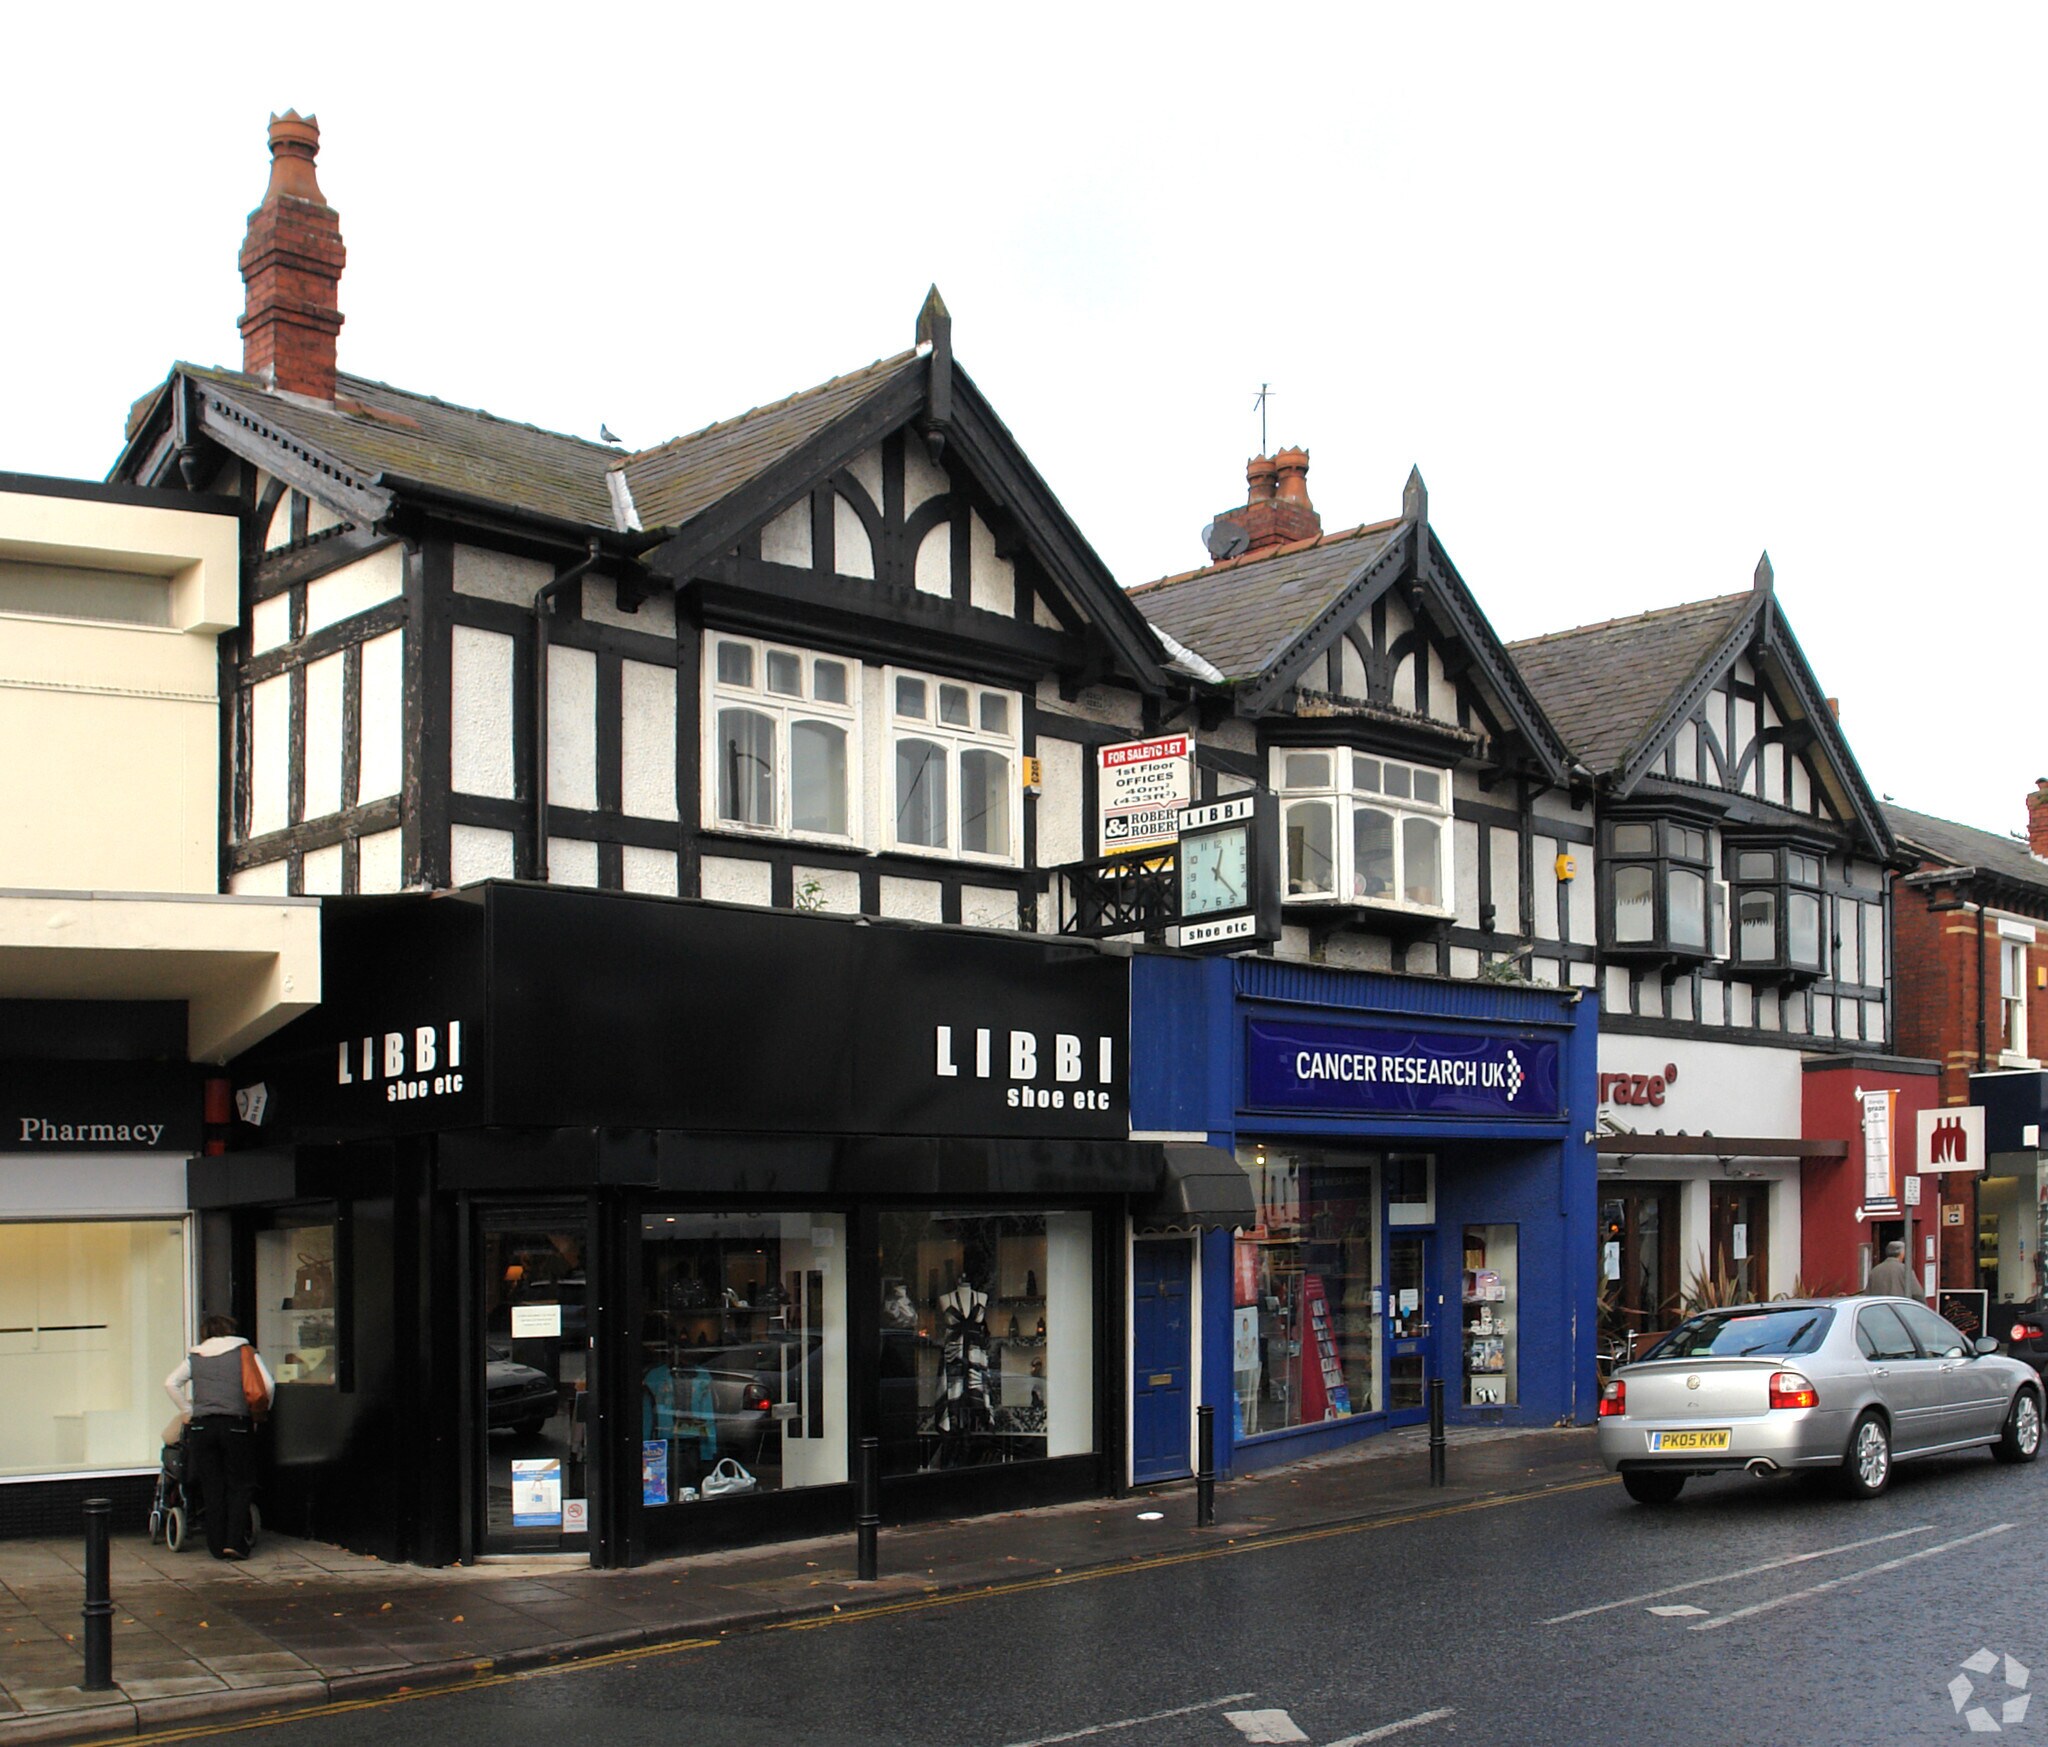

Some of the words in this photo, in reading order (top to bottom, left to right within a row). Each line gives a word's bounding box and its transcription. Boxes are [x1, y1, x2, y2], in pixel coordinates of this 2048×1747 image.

[1107, 751, 1126, 764] FOR
[1164, 741, 1181, 754] LET
[1116, 767, 1135, 776] 1st
[1140, 762, 1175, 773] Floor
[1116, 772, 1174, 787] OFFICES
[1187, 801, 1244, 826] LIBBI
[1188, 926, 1220, 940] shoe
[1226, 922, 1248, 934] etc
[338, 1020, 460, 1085] LIBBI
[936, 1025, 1112, 1083] LIBBI
[1296, 1051, 1377, 1081] CANCER
[1381, 1056, 1477, 1086] RESEARCH
[1481, 1062, 1505, 1088] UK
[387, 1079, 428, 1102] shoe
[434, 1074, 463, 1095] etc
[1007, 1085, 1064, 1109] shoe
[1073, 1089, 1110, 1110] etc
[1597, 1073, 1665, 1107] raze
[19, 1117, 164, 1145] Pharmacy
[1662, 1433, 1697, 1447] PK05
[1700, 1432, 1727, 1446] KKW
